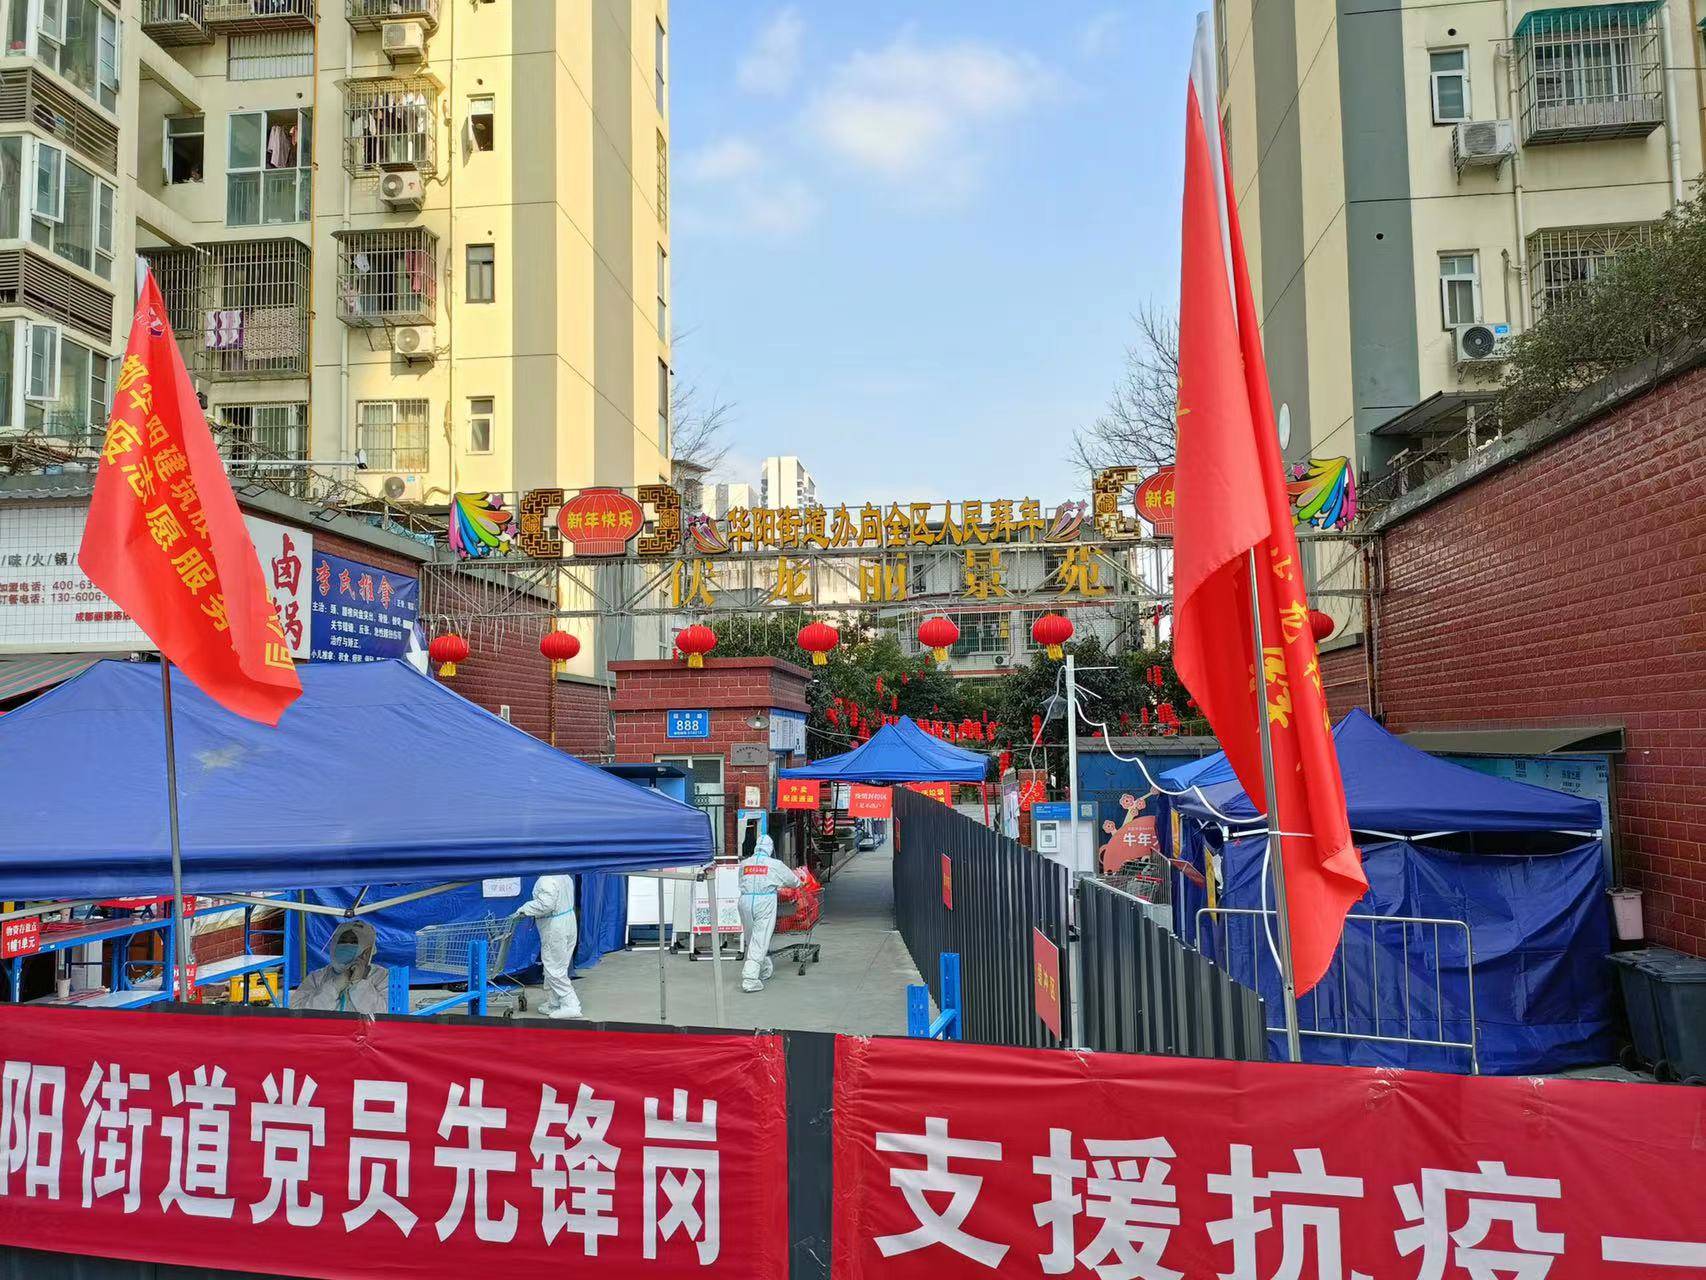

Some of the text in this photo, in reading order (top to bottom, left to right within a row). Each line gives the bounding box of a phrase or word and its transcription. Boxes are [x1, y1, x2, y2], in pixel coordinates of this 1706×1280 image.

[567, 509, 633, 530] 新年快乐
[727, 497, 1045, 553] 华阳街道办向全区人民拜年
[676, 720, 699, 731] 888
[0, 1060, 722, 1267] 阳街道党员先锋岗
[873, 1116, 1706, 1280] 支援抗疫一
